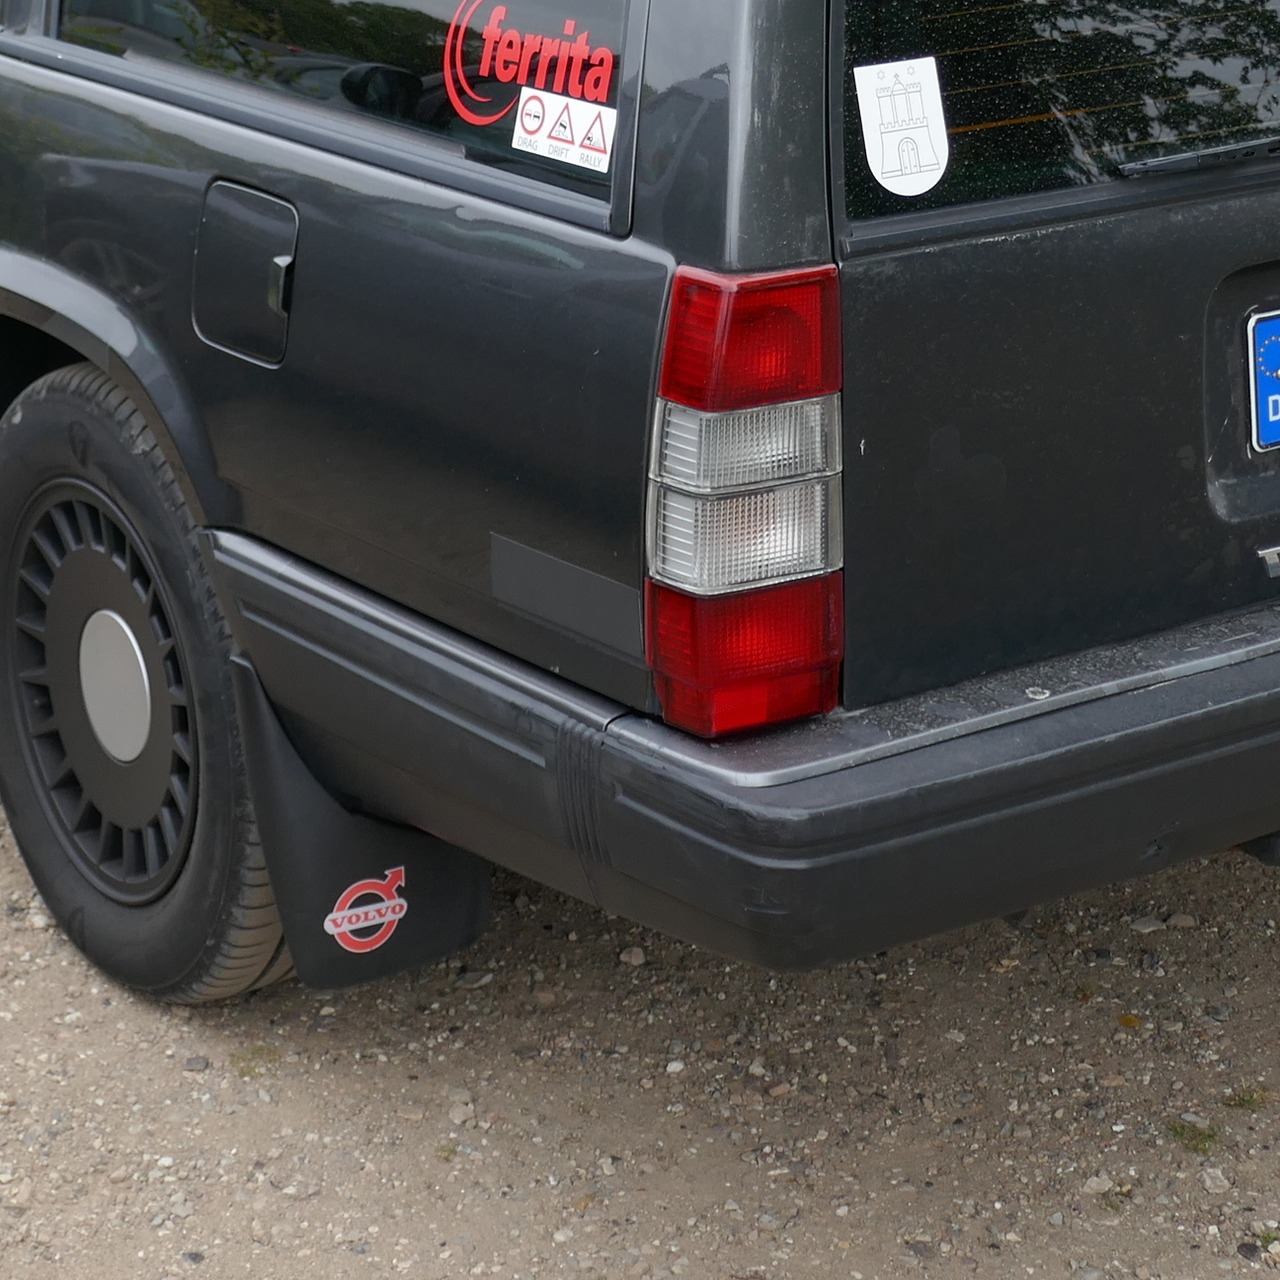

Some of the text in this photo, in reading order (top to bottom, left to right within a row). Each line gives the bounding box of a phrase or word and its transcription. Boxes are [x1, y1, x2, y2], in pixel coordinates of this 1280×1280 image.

[478, 5, 614, 103] ferrita
[517, 135, 603, 168] DRAG DRIFT RALLY
[328, 903, 405, 929] VOLVO
